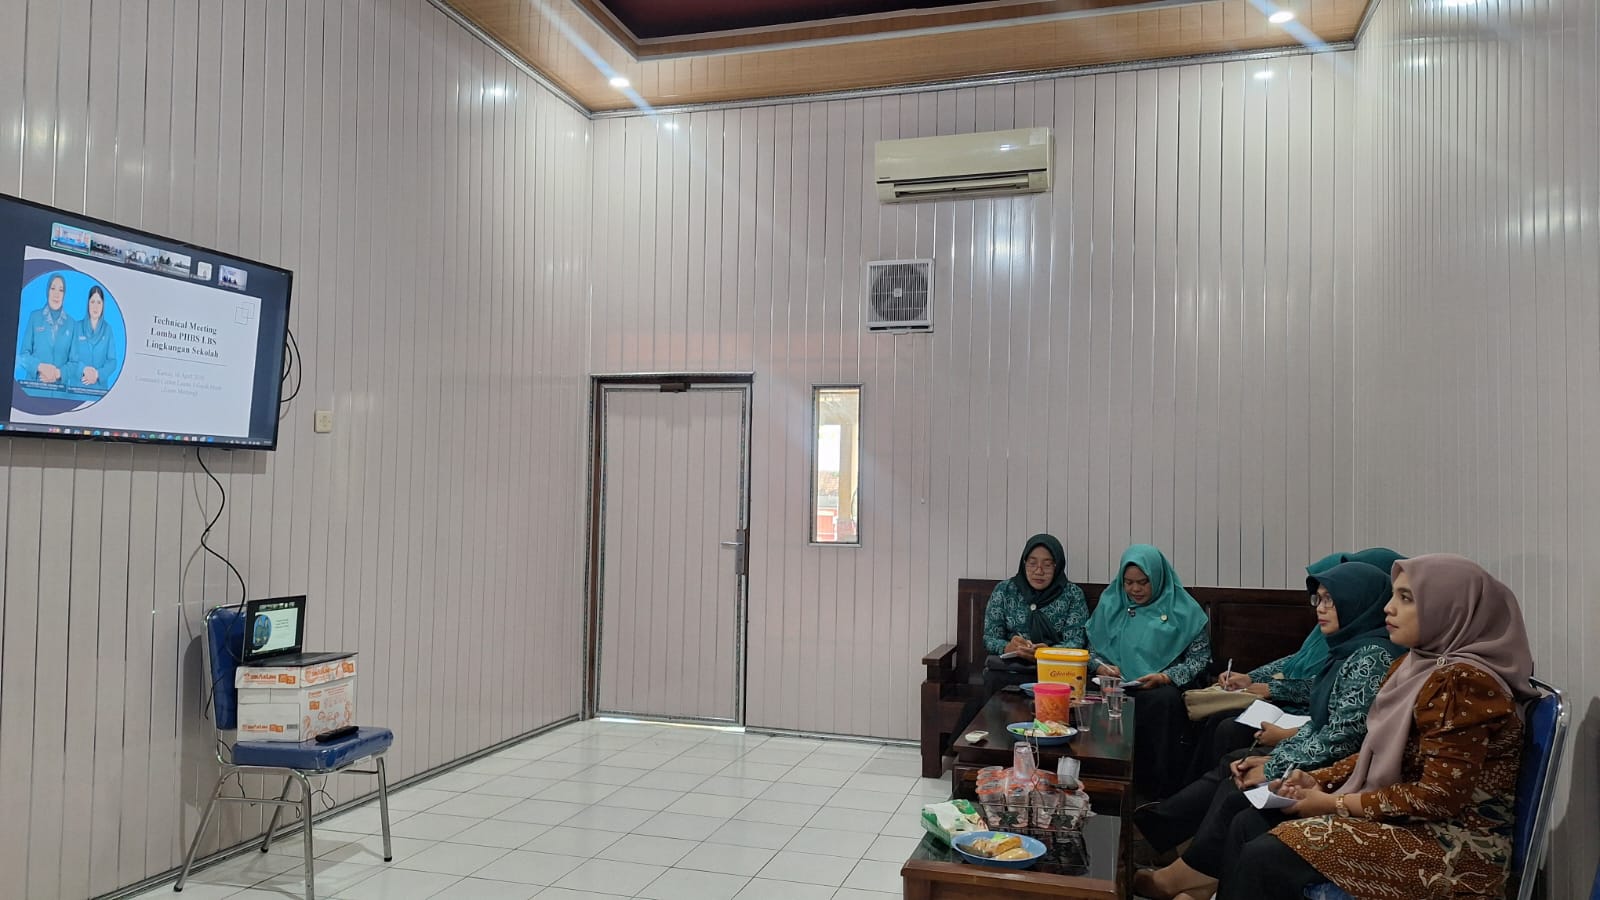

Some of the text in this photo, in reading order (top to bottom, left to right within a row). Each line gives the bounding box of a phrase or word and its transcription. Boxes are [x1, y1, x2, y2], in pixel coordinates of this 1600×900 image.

[153, 315, 217, 335] Technical Meeting
[150, 327, 217, 346] Lomba PHBS LBS
[146, 339, 219, 358] Lingkungan Sekolah
